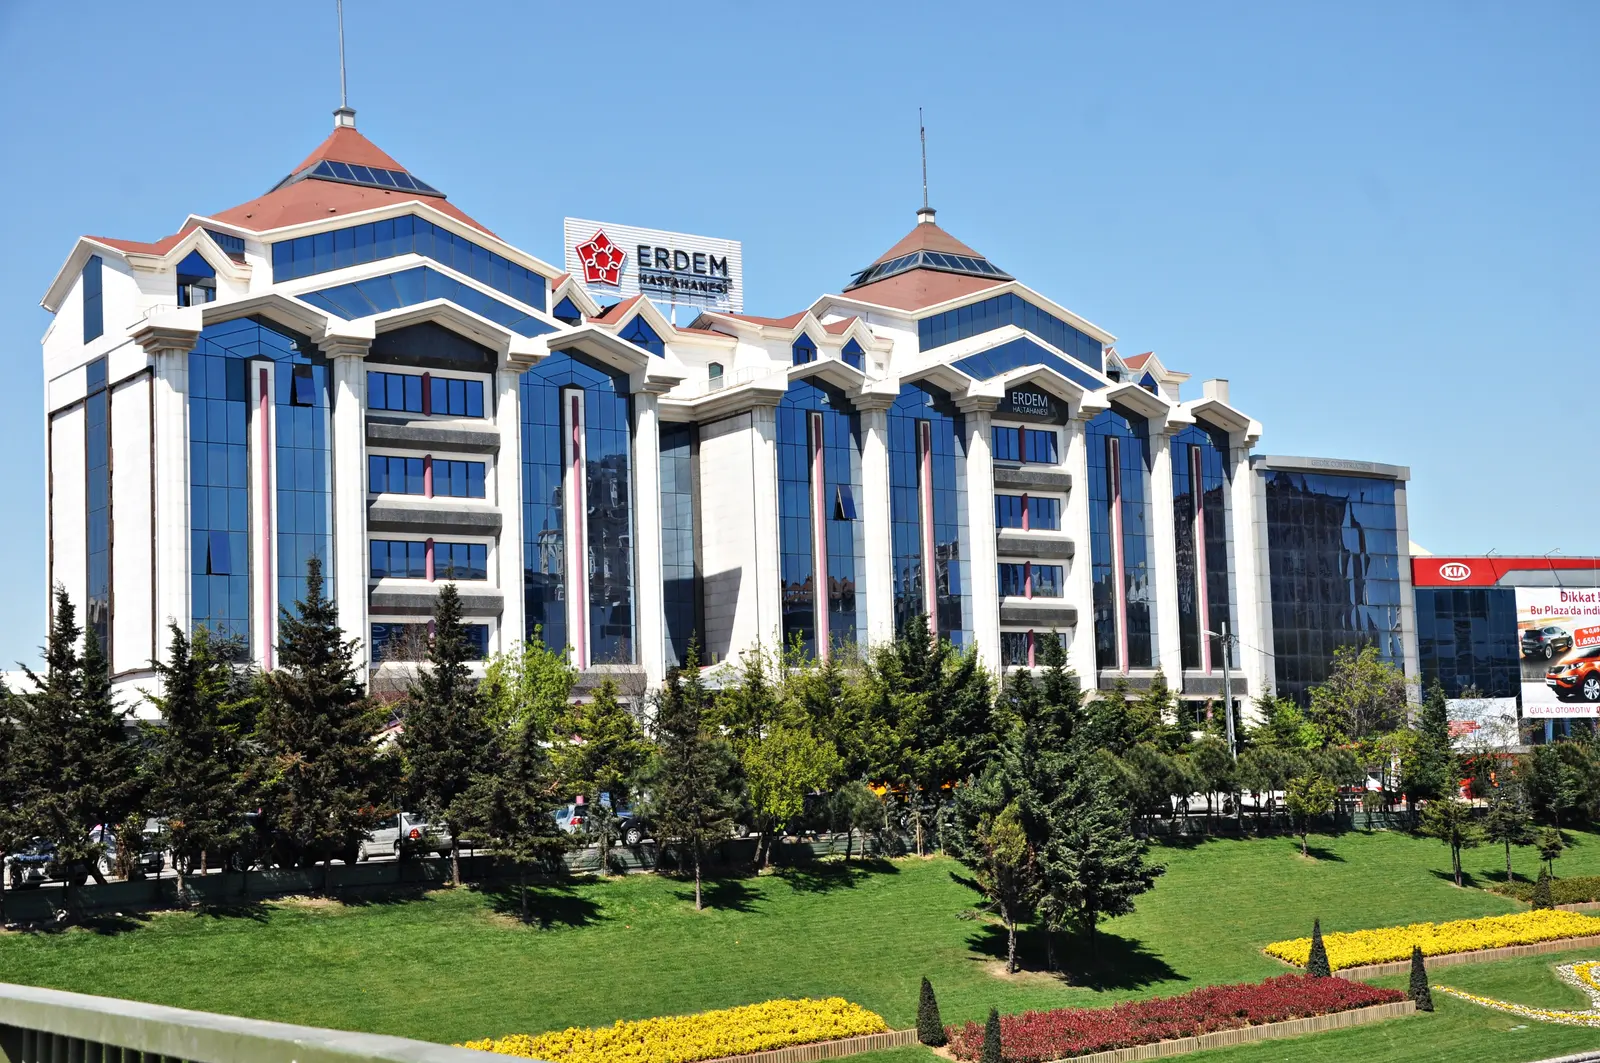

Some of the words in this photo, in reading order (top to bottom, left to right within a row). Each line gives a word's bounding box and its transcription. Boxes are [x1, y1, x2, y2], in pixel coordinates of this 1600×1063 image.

[637, 245, 727, 276] ERDEM
[1012, 391, 1048, 407] ERDEM
[1445, 566, 1466, 577] KIA
[1560, 591, 1595, 603] Dikkat
[1530, 605, 1543, 615] Bu
[1544, 605, 1582, 615] Plaza'da
